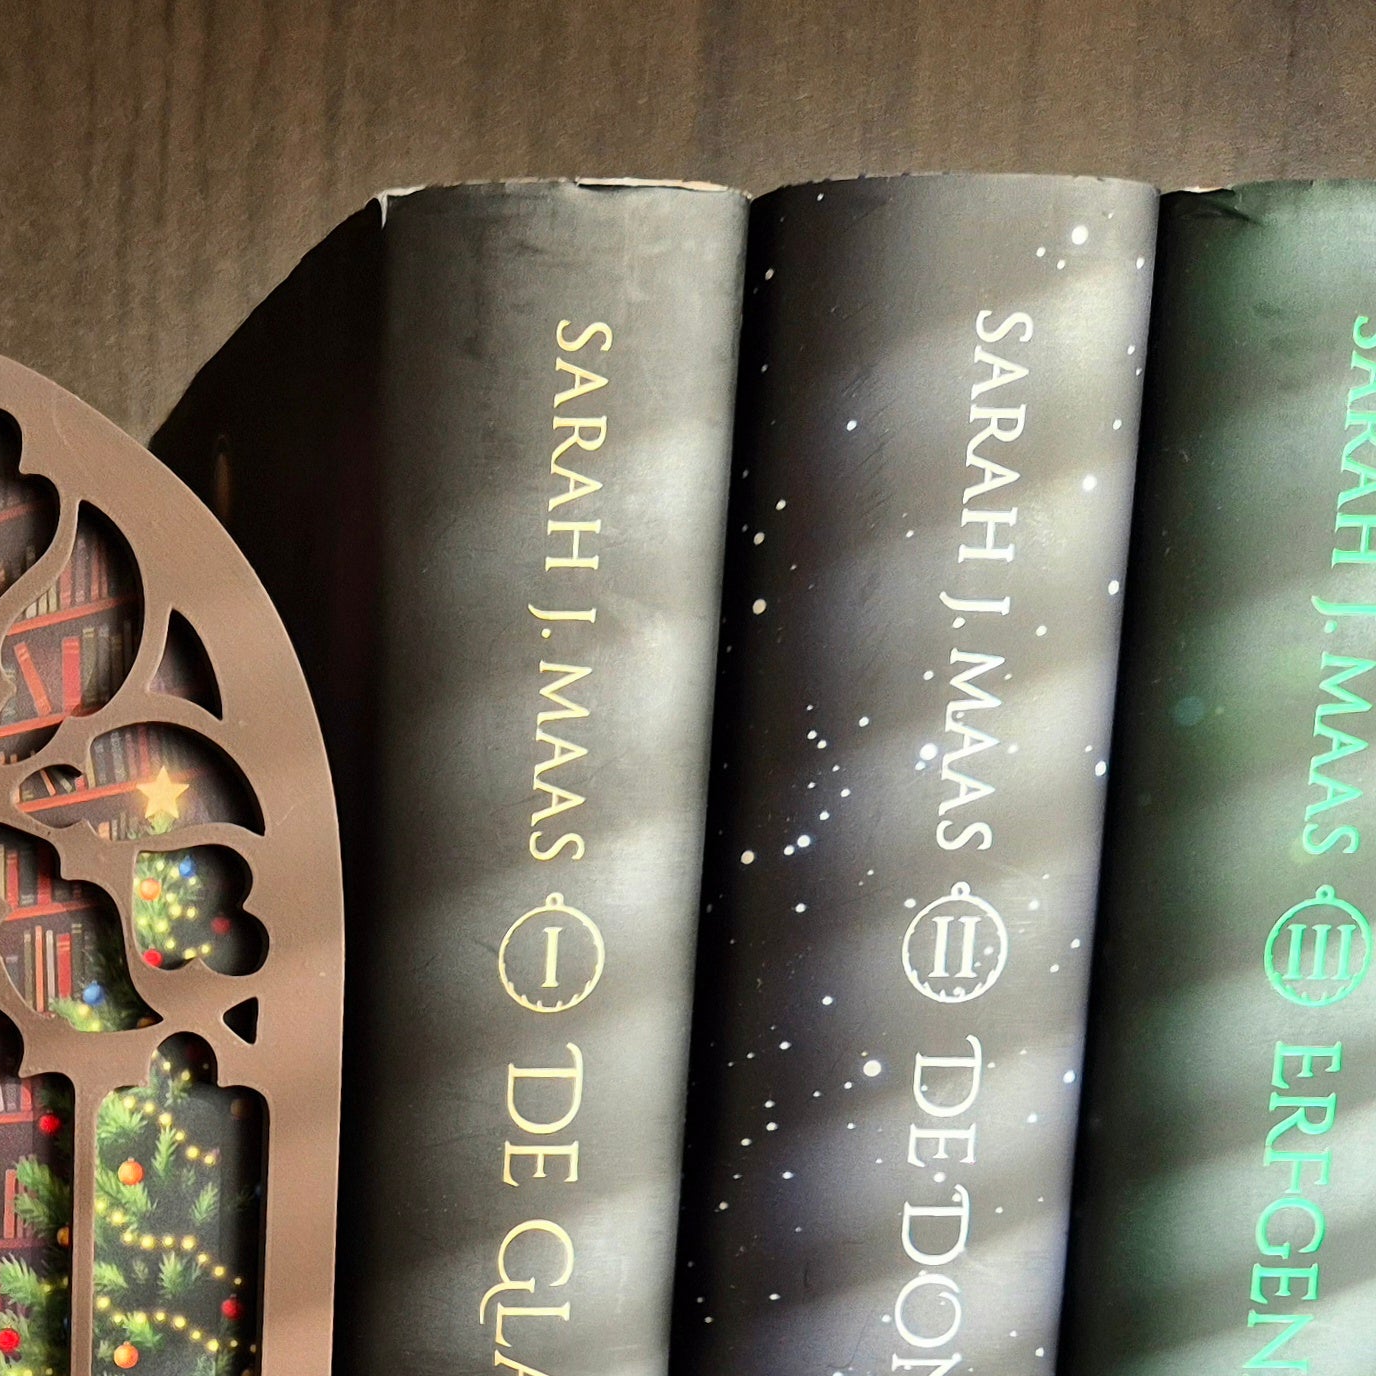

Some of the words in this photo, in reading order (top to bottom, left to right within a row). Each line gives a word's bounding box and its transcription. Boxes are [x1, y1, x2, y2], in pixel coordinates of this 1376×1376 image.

[544, 319, 613, 573] SARAH
[957, 309, 1033, 564] SARAH
[528, 603, 597, 640] J.
[939, 592, 1011, 629] J.
[528, 659, 593, 863] MAAS
[935, 646, 1005, 854] MAAS
[1301, 650, 1376, 857] MAAS
[503, 1042, 585, 1188] DE
[906, 1034, 982, 1168] DE
